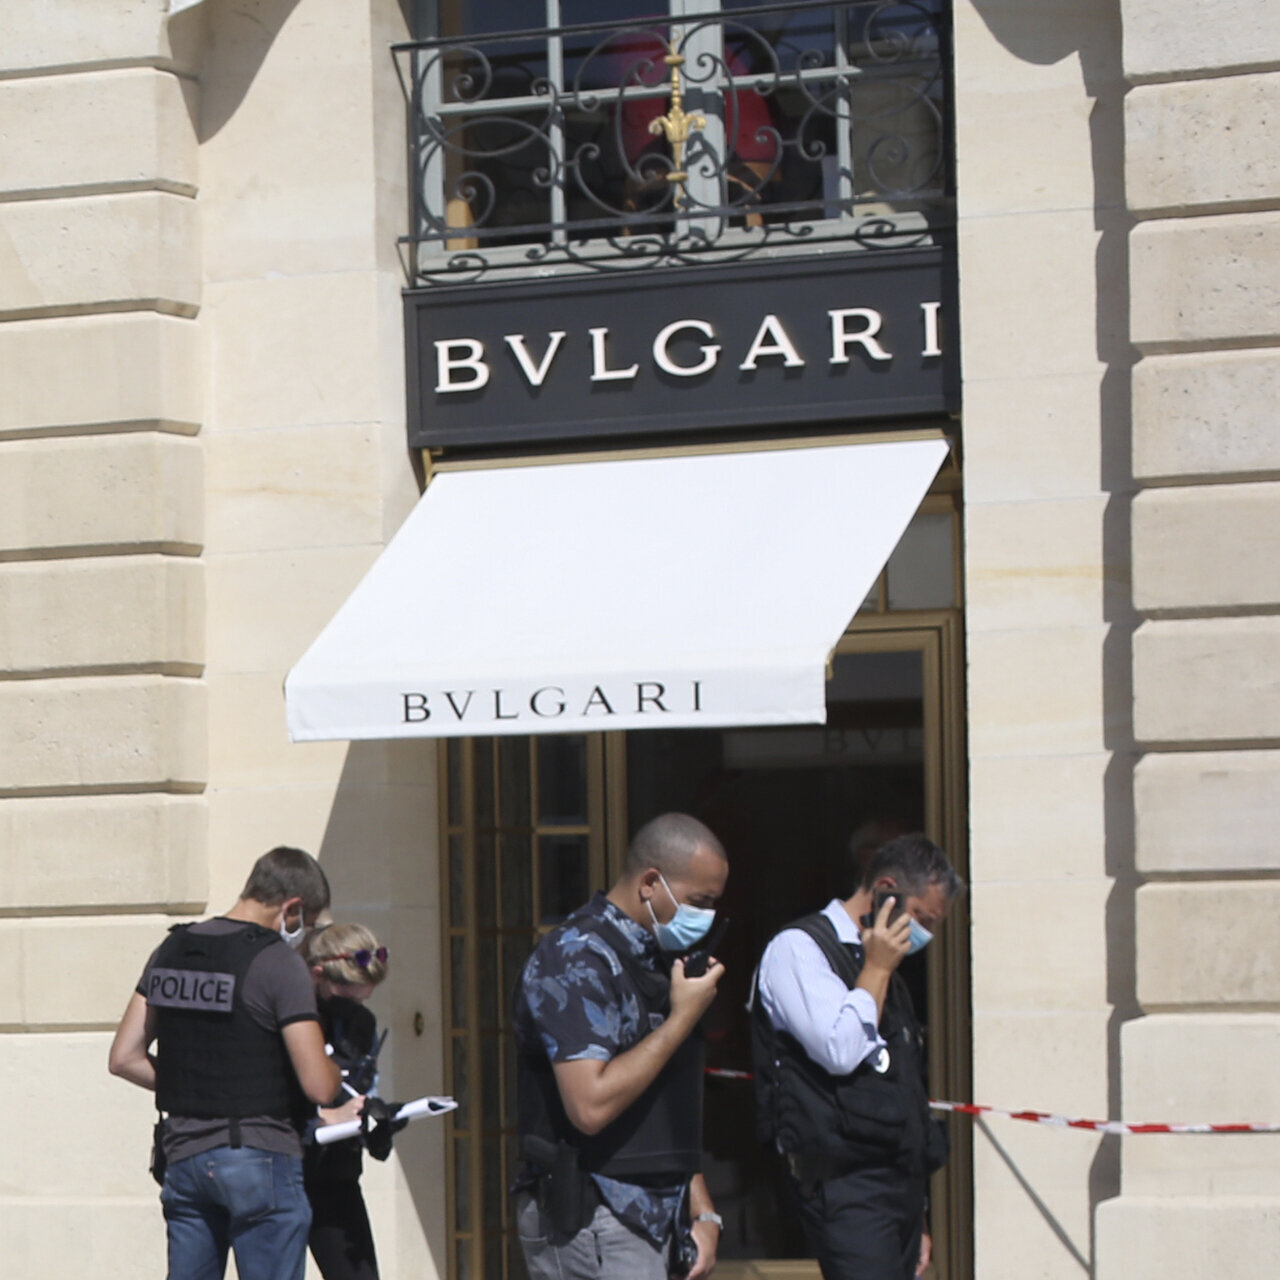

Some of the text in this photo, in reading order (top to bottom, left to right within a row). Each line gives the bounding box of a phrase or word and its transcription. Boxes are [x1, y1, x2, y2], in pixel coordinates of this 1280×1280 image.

[433, 302, 941, 393] BVLGARI
[401, 680, 702, 723] BVLGARI
[150, 975, 230, 1004] POLICE
